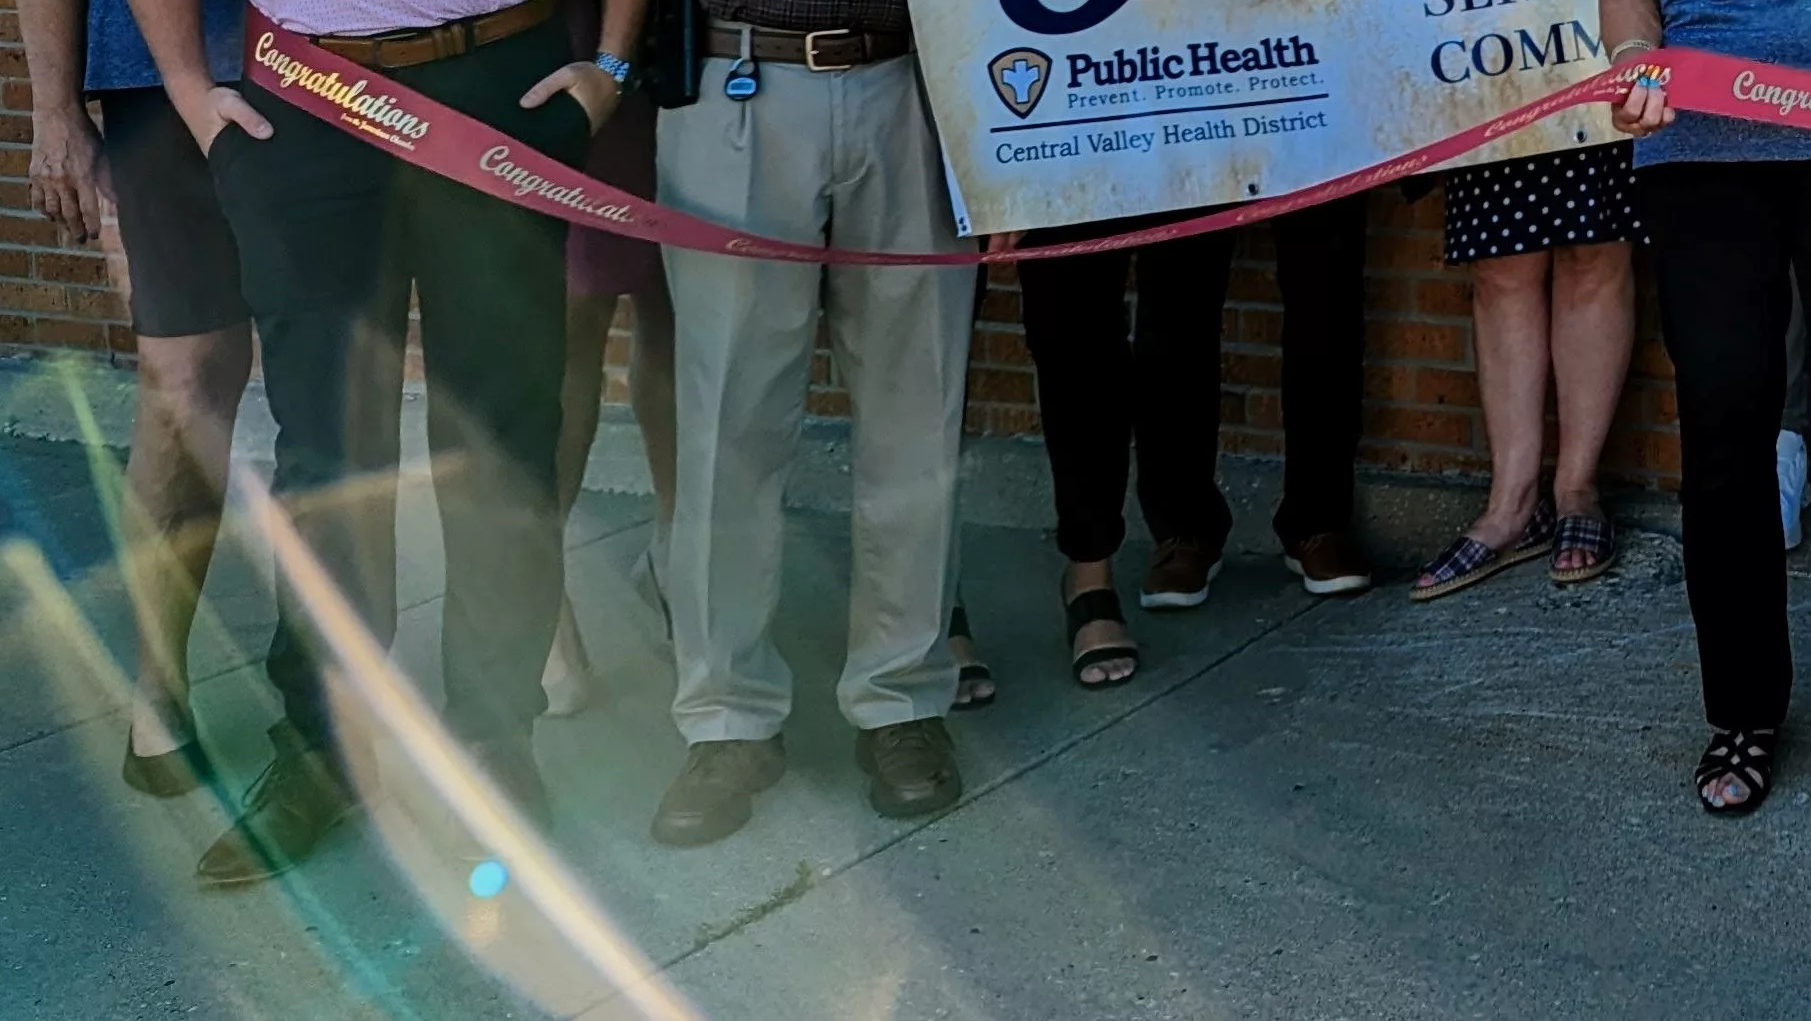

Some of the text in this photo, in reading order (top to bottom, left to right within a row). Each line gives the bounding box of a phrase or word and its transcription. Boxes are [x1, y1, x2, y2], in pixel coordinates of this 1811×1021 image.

[254, 31, 431, 140] Congratulations
[1066, 34, 1319, 89] Public Health
[1067, 71, 1325, 109] Prevent. Promote. Protect.
[995, 110, 1329, 165] Central Valley Health District
